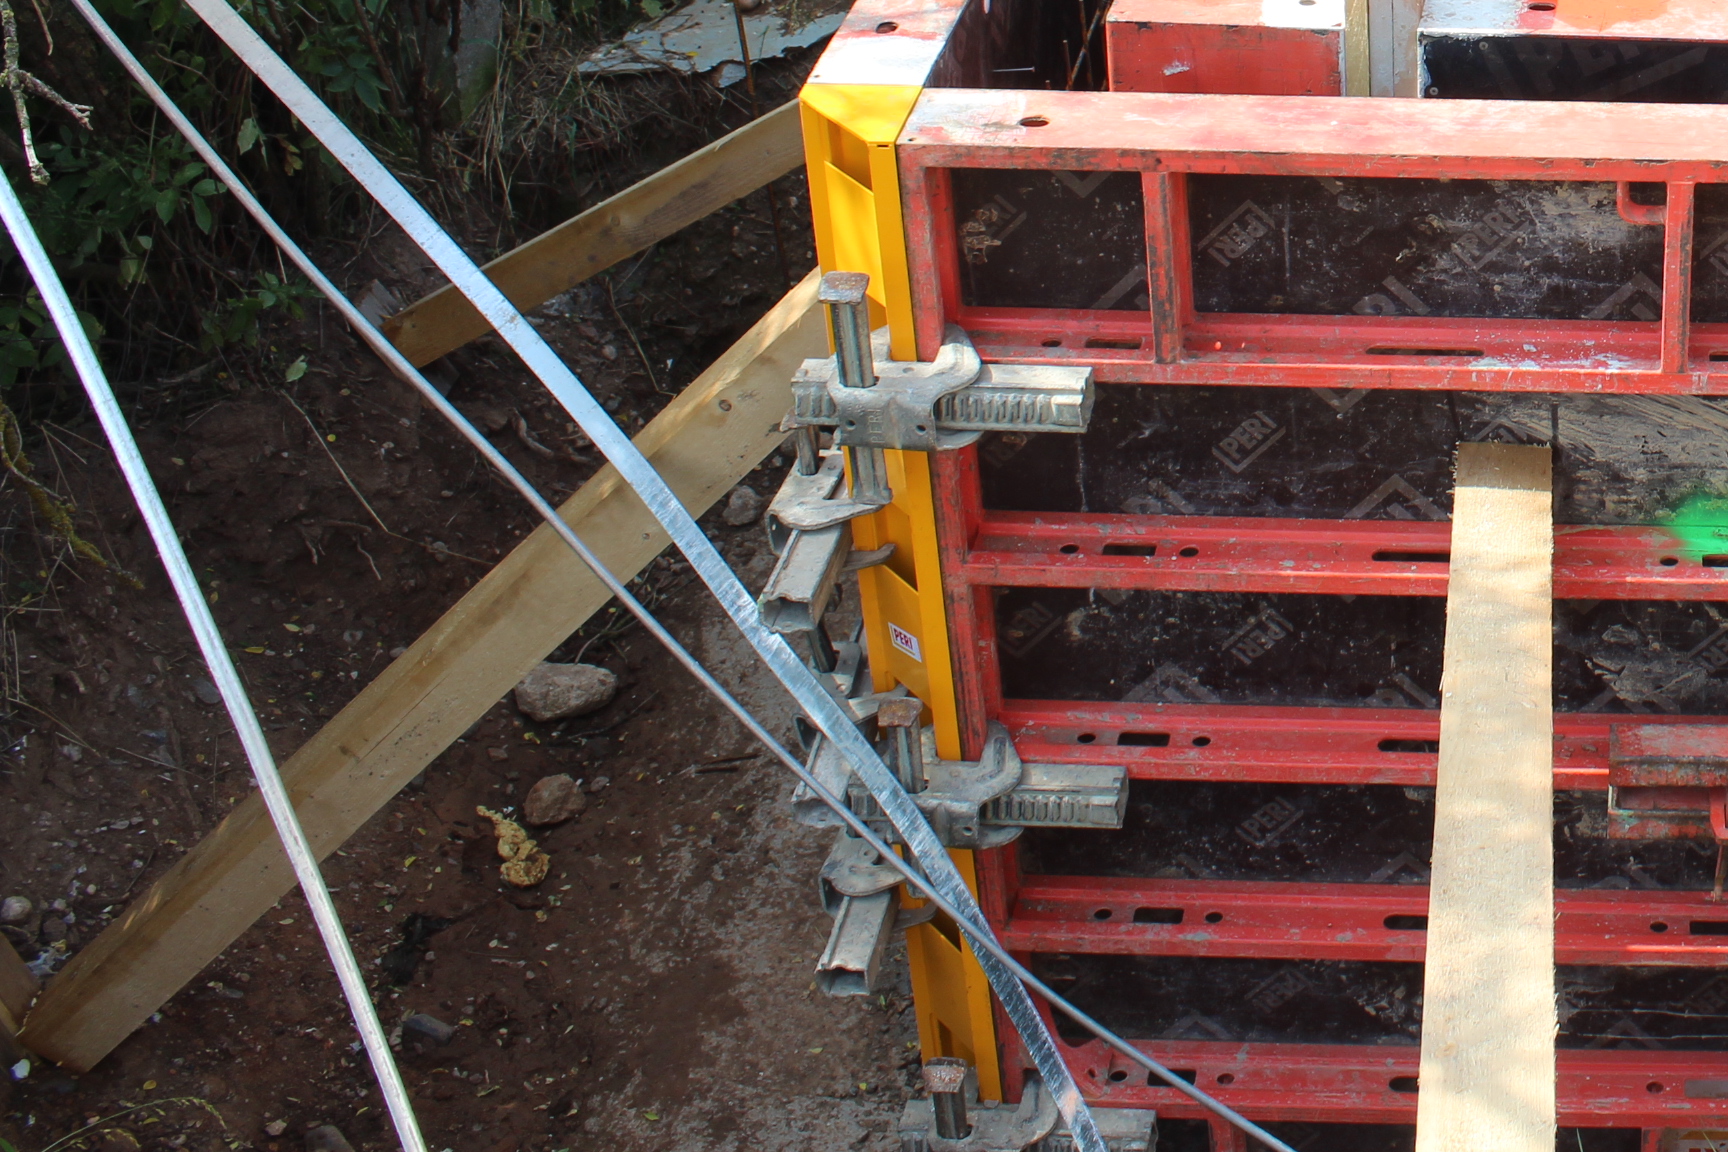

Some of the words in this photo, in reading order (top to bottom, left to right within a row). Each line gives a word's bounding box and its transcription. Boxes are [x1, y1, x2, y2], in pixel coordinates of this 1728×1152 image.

[1206, 211, 1268, 268] PERI
[1221, 411, 1278, 460] PERI
[893, 627, 914, 651] PERI
[1230, 619, 1288, 666] PERI
[1243, 797, 1298, 838] PERI
